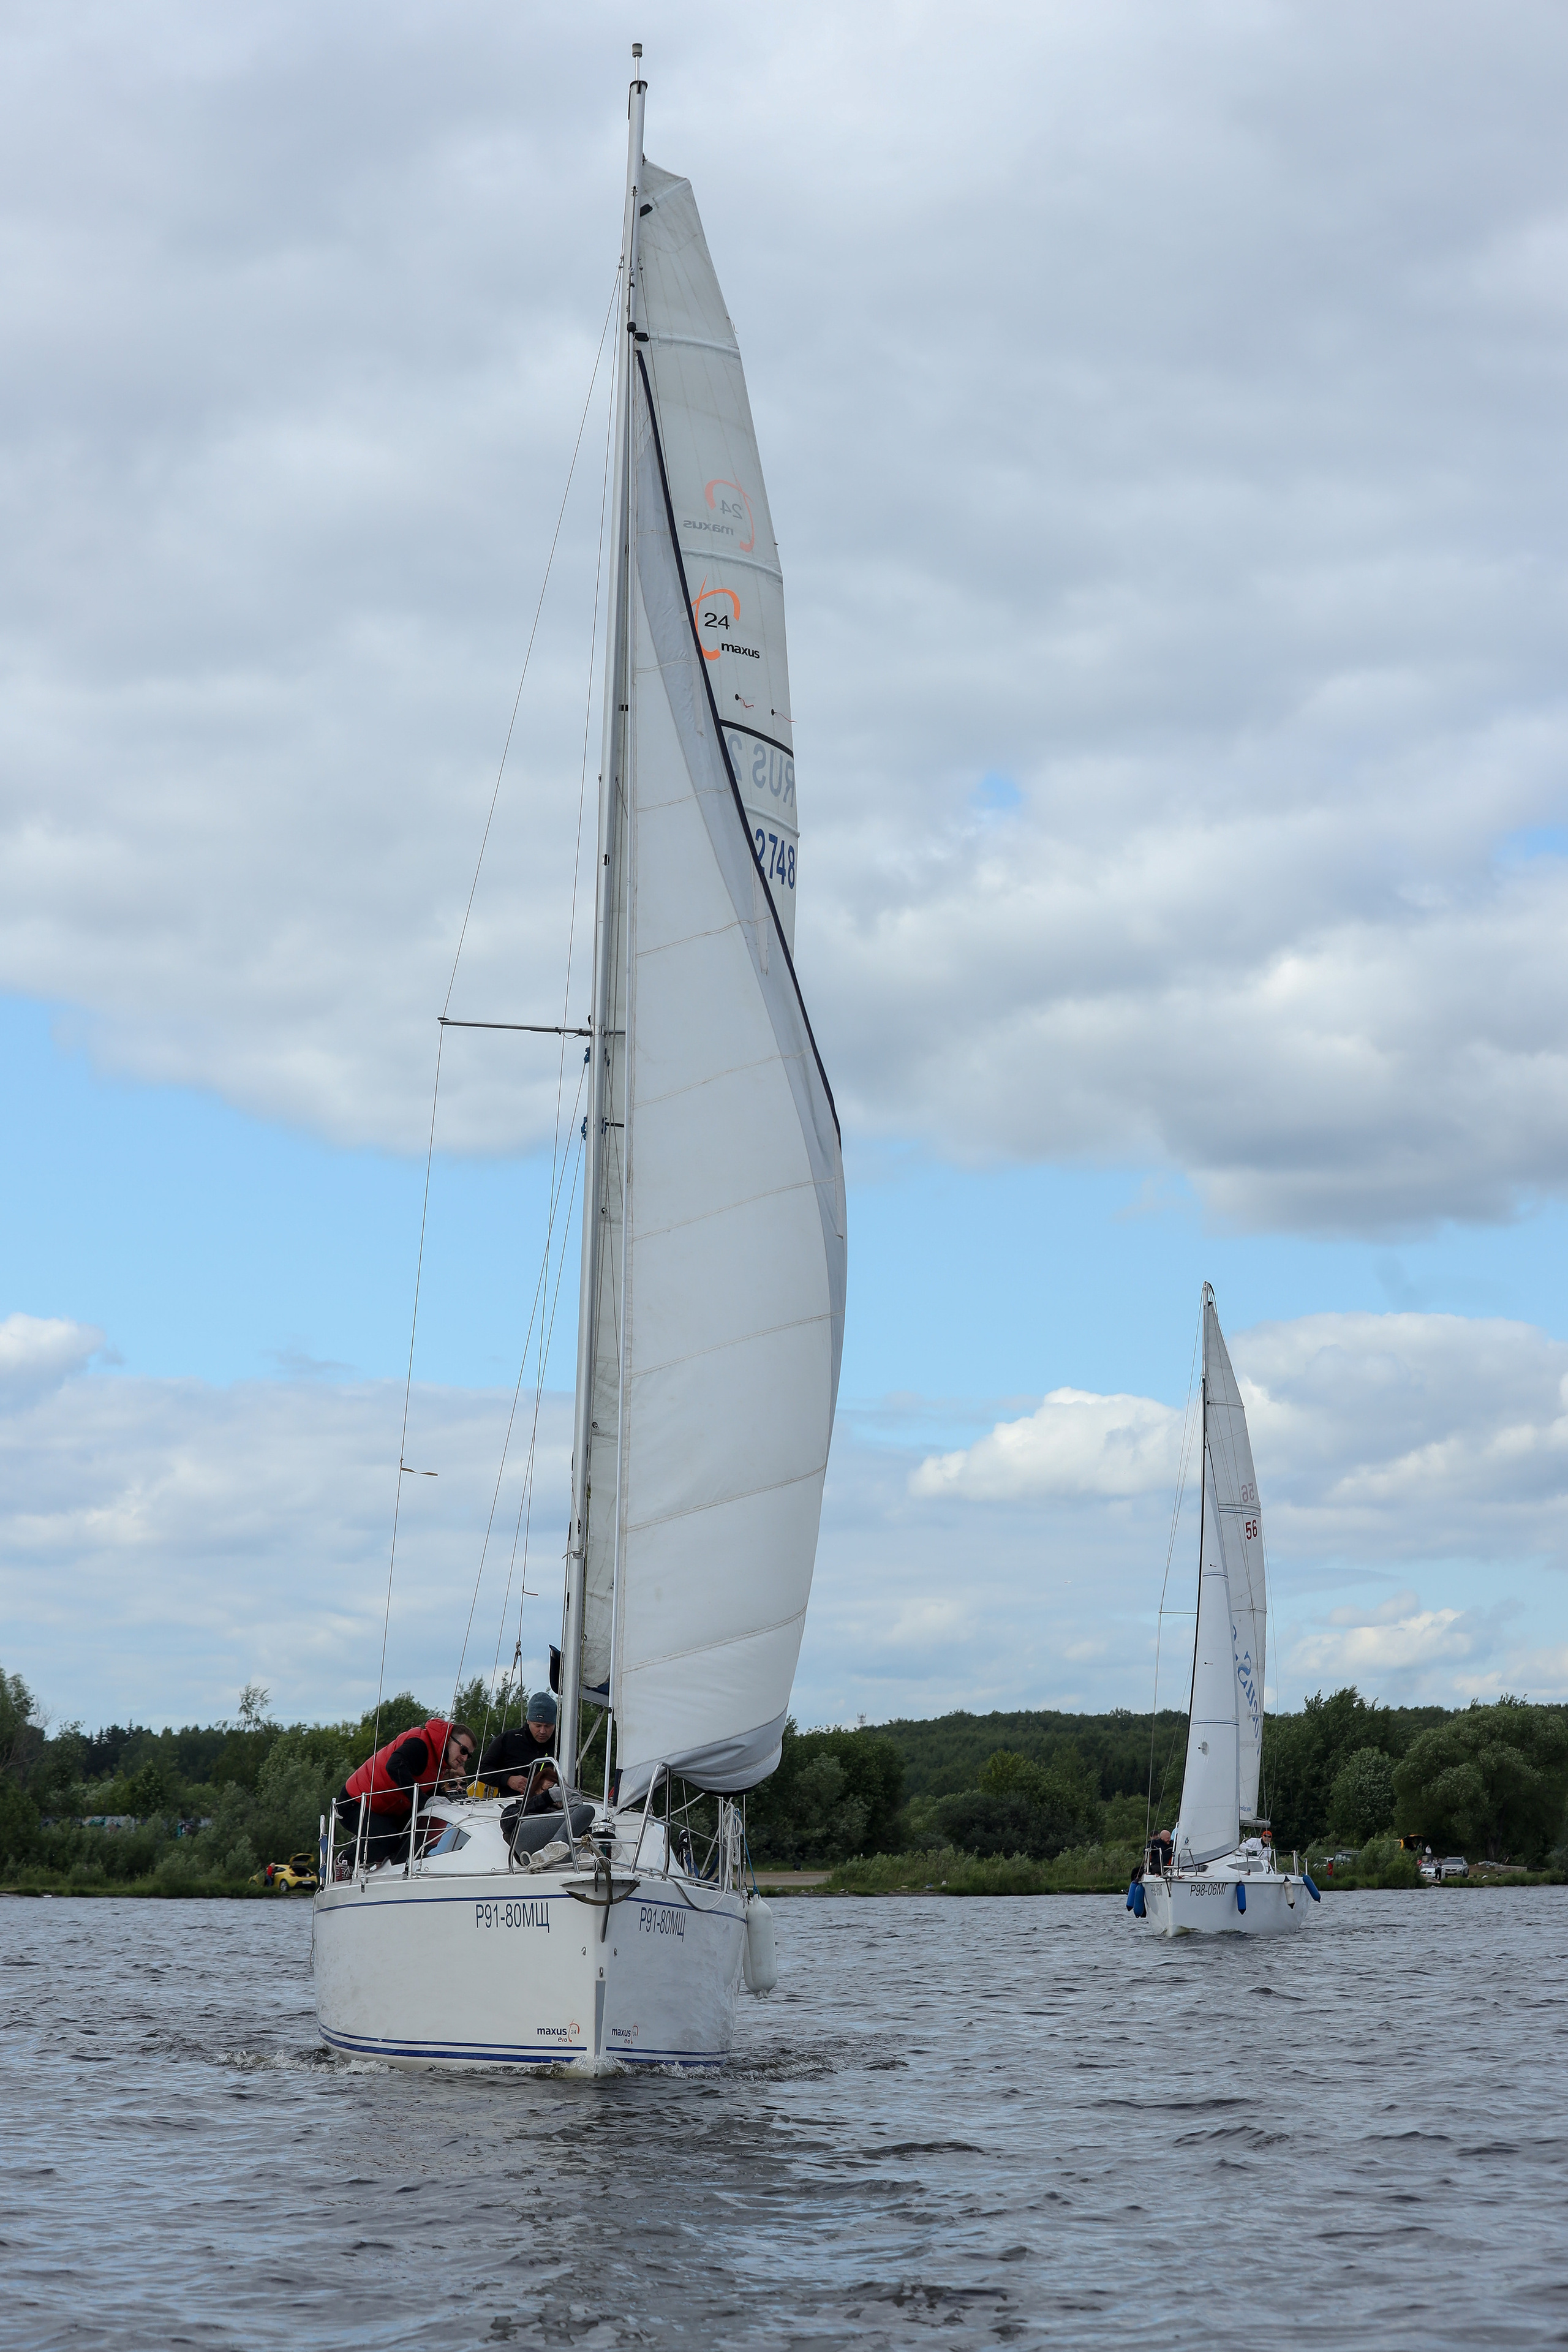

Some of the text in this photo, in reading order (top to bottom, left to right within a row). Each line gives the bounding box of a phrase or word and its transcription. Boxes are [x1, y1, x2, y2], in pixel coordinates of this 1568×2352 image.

[704, 612, 730, 630] 24
[721, 641, 760, 659] maxus
[755, 828, 795, 889] 2748
[1245, 1519, 1257, 1540] 56
[476, 1902, 549, 1933] Р91-80МЩ
[639, 1906, 687, 1943] Р91-80МЩ
[611, 2028, 631, 2037] maxus
